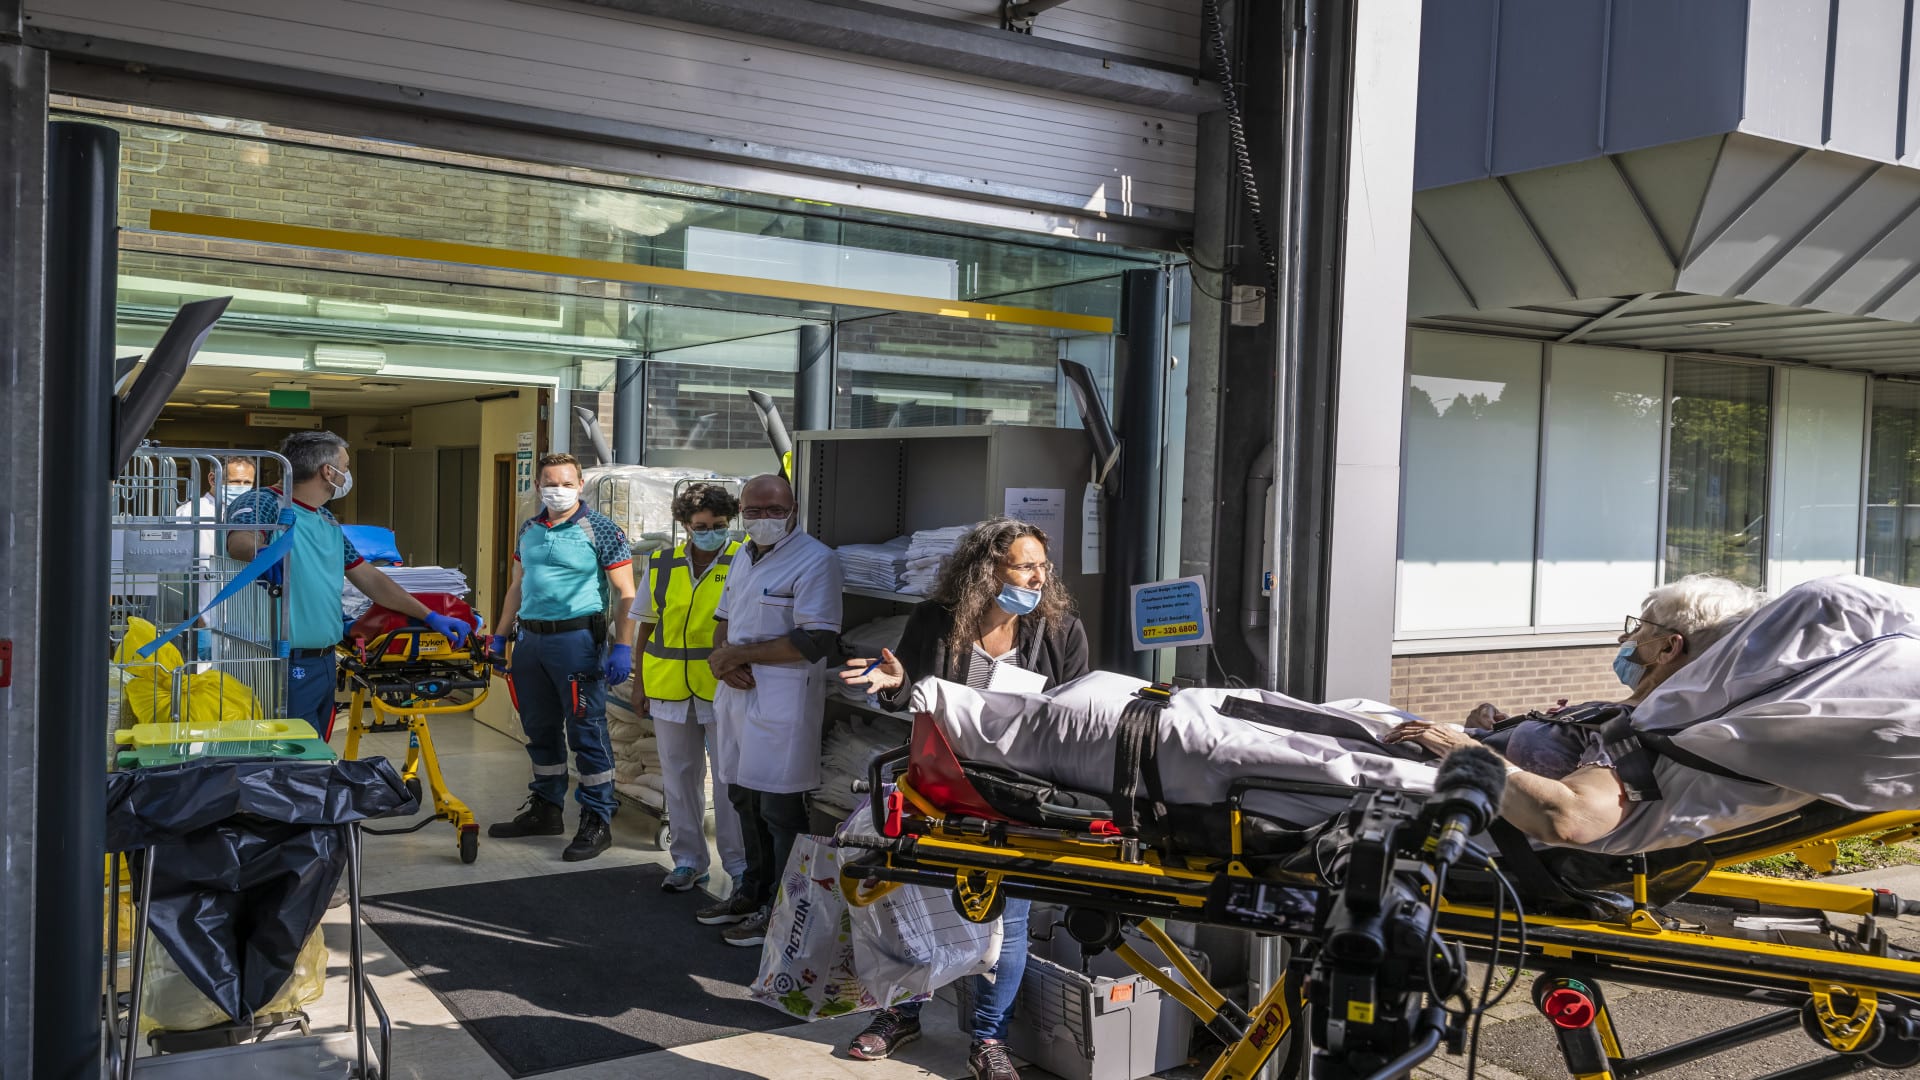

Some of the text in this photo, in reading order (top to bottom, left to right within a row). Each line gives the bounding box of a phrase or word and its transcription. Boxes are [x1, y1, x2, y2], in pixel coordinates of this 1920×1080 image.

[1143, 629, 1156, 637] 077
[1163, 627, 1177, 635] 320
[1178, 624, 1198, 633] 6800
[785, 899, 811, 960] ACTION
[1249, 1010, 1279, 1050] M-1
